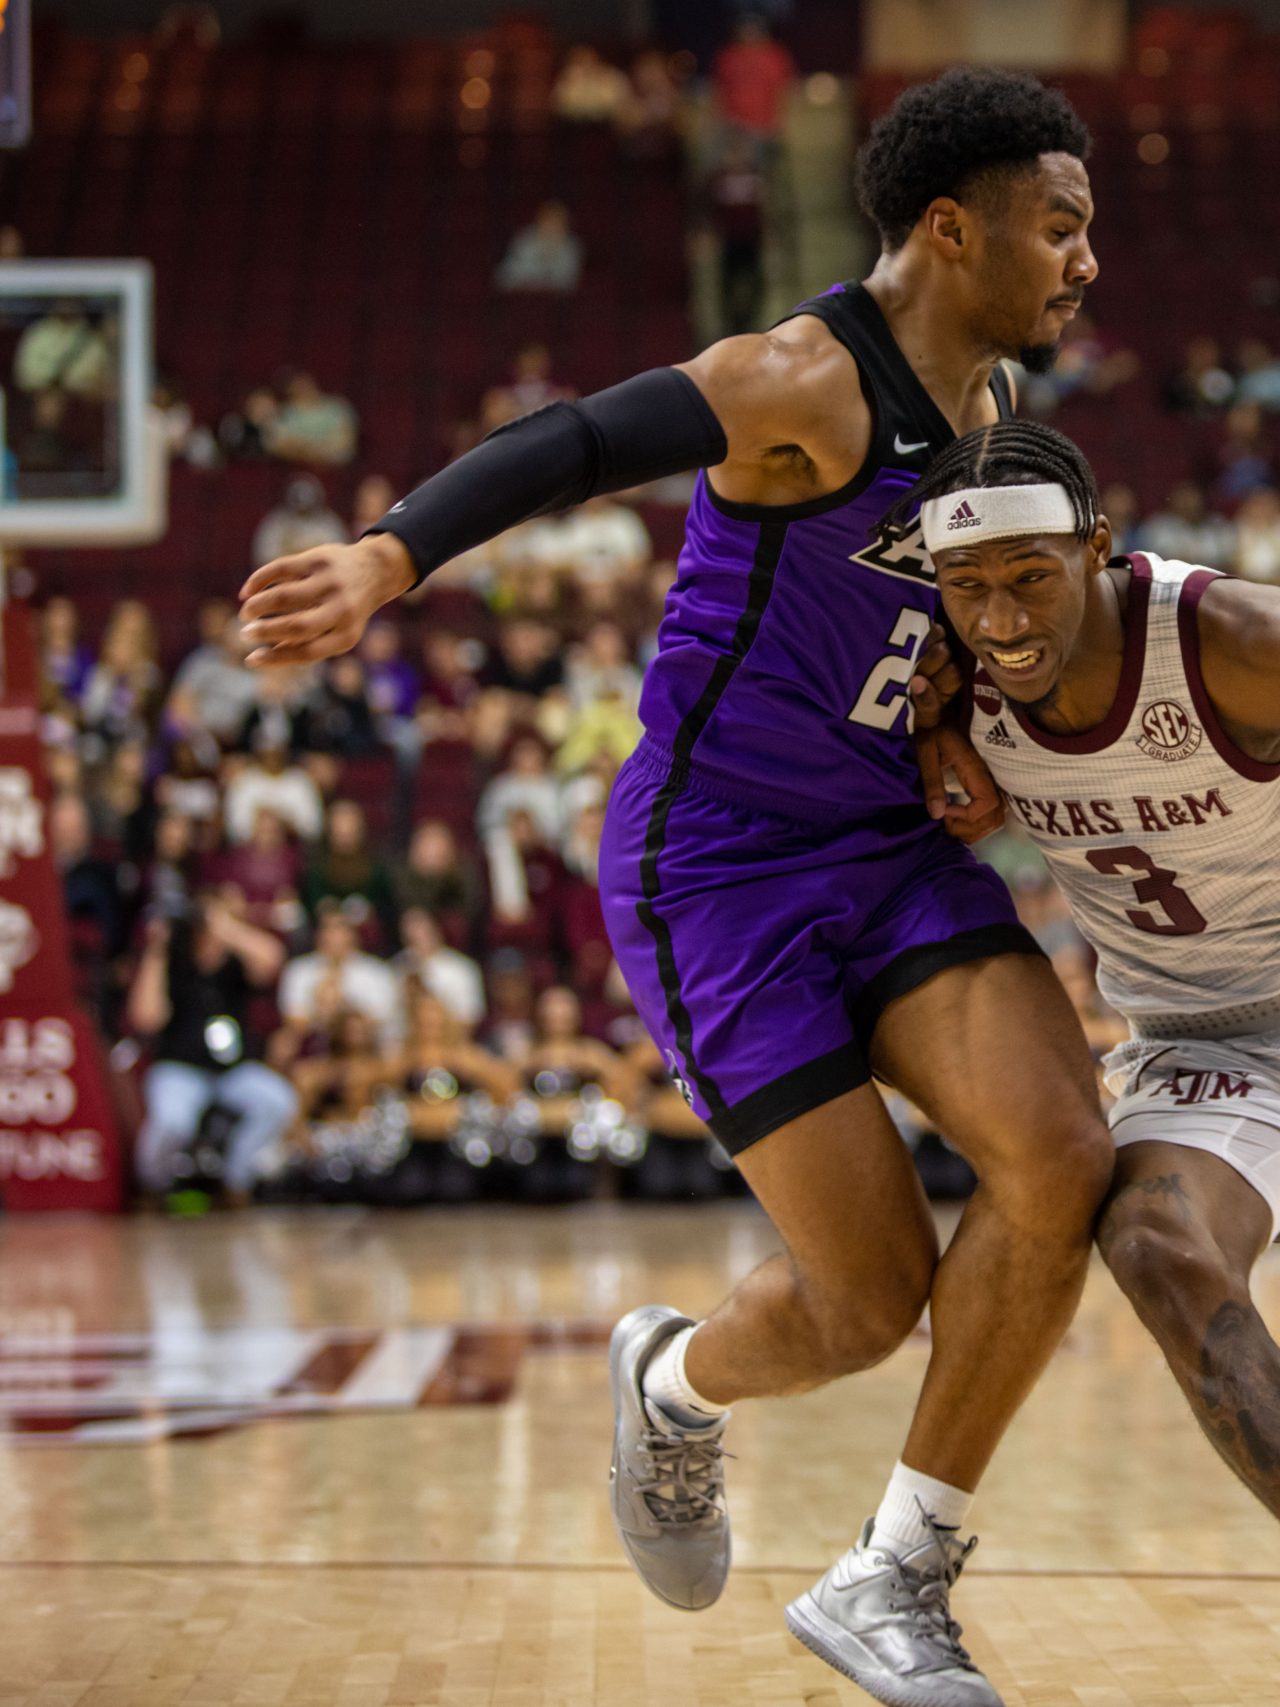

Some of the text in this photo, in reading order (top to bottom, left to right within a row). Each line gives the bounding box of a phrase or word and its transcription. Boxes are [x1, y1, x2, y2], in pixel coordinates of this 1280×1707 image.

[947, 517, 982, 531] adidas
[848, 607, 931, 735] 2
[985, 735, 1017, 750] adidas
[1143, 702, 1188, 748] SEC
[1148, 738, 1199, 760] GRADUATE
[1132, 787, 1233, 832] A&M
[1085, 845, 1208, 936] 3
